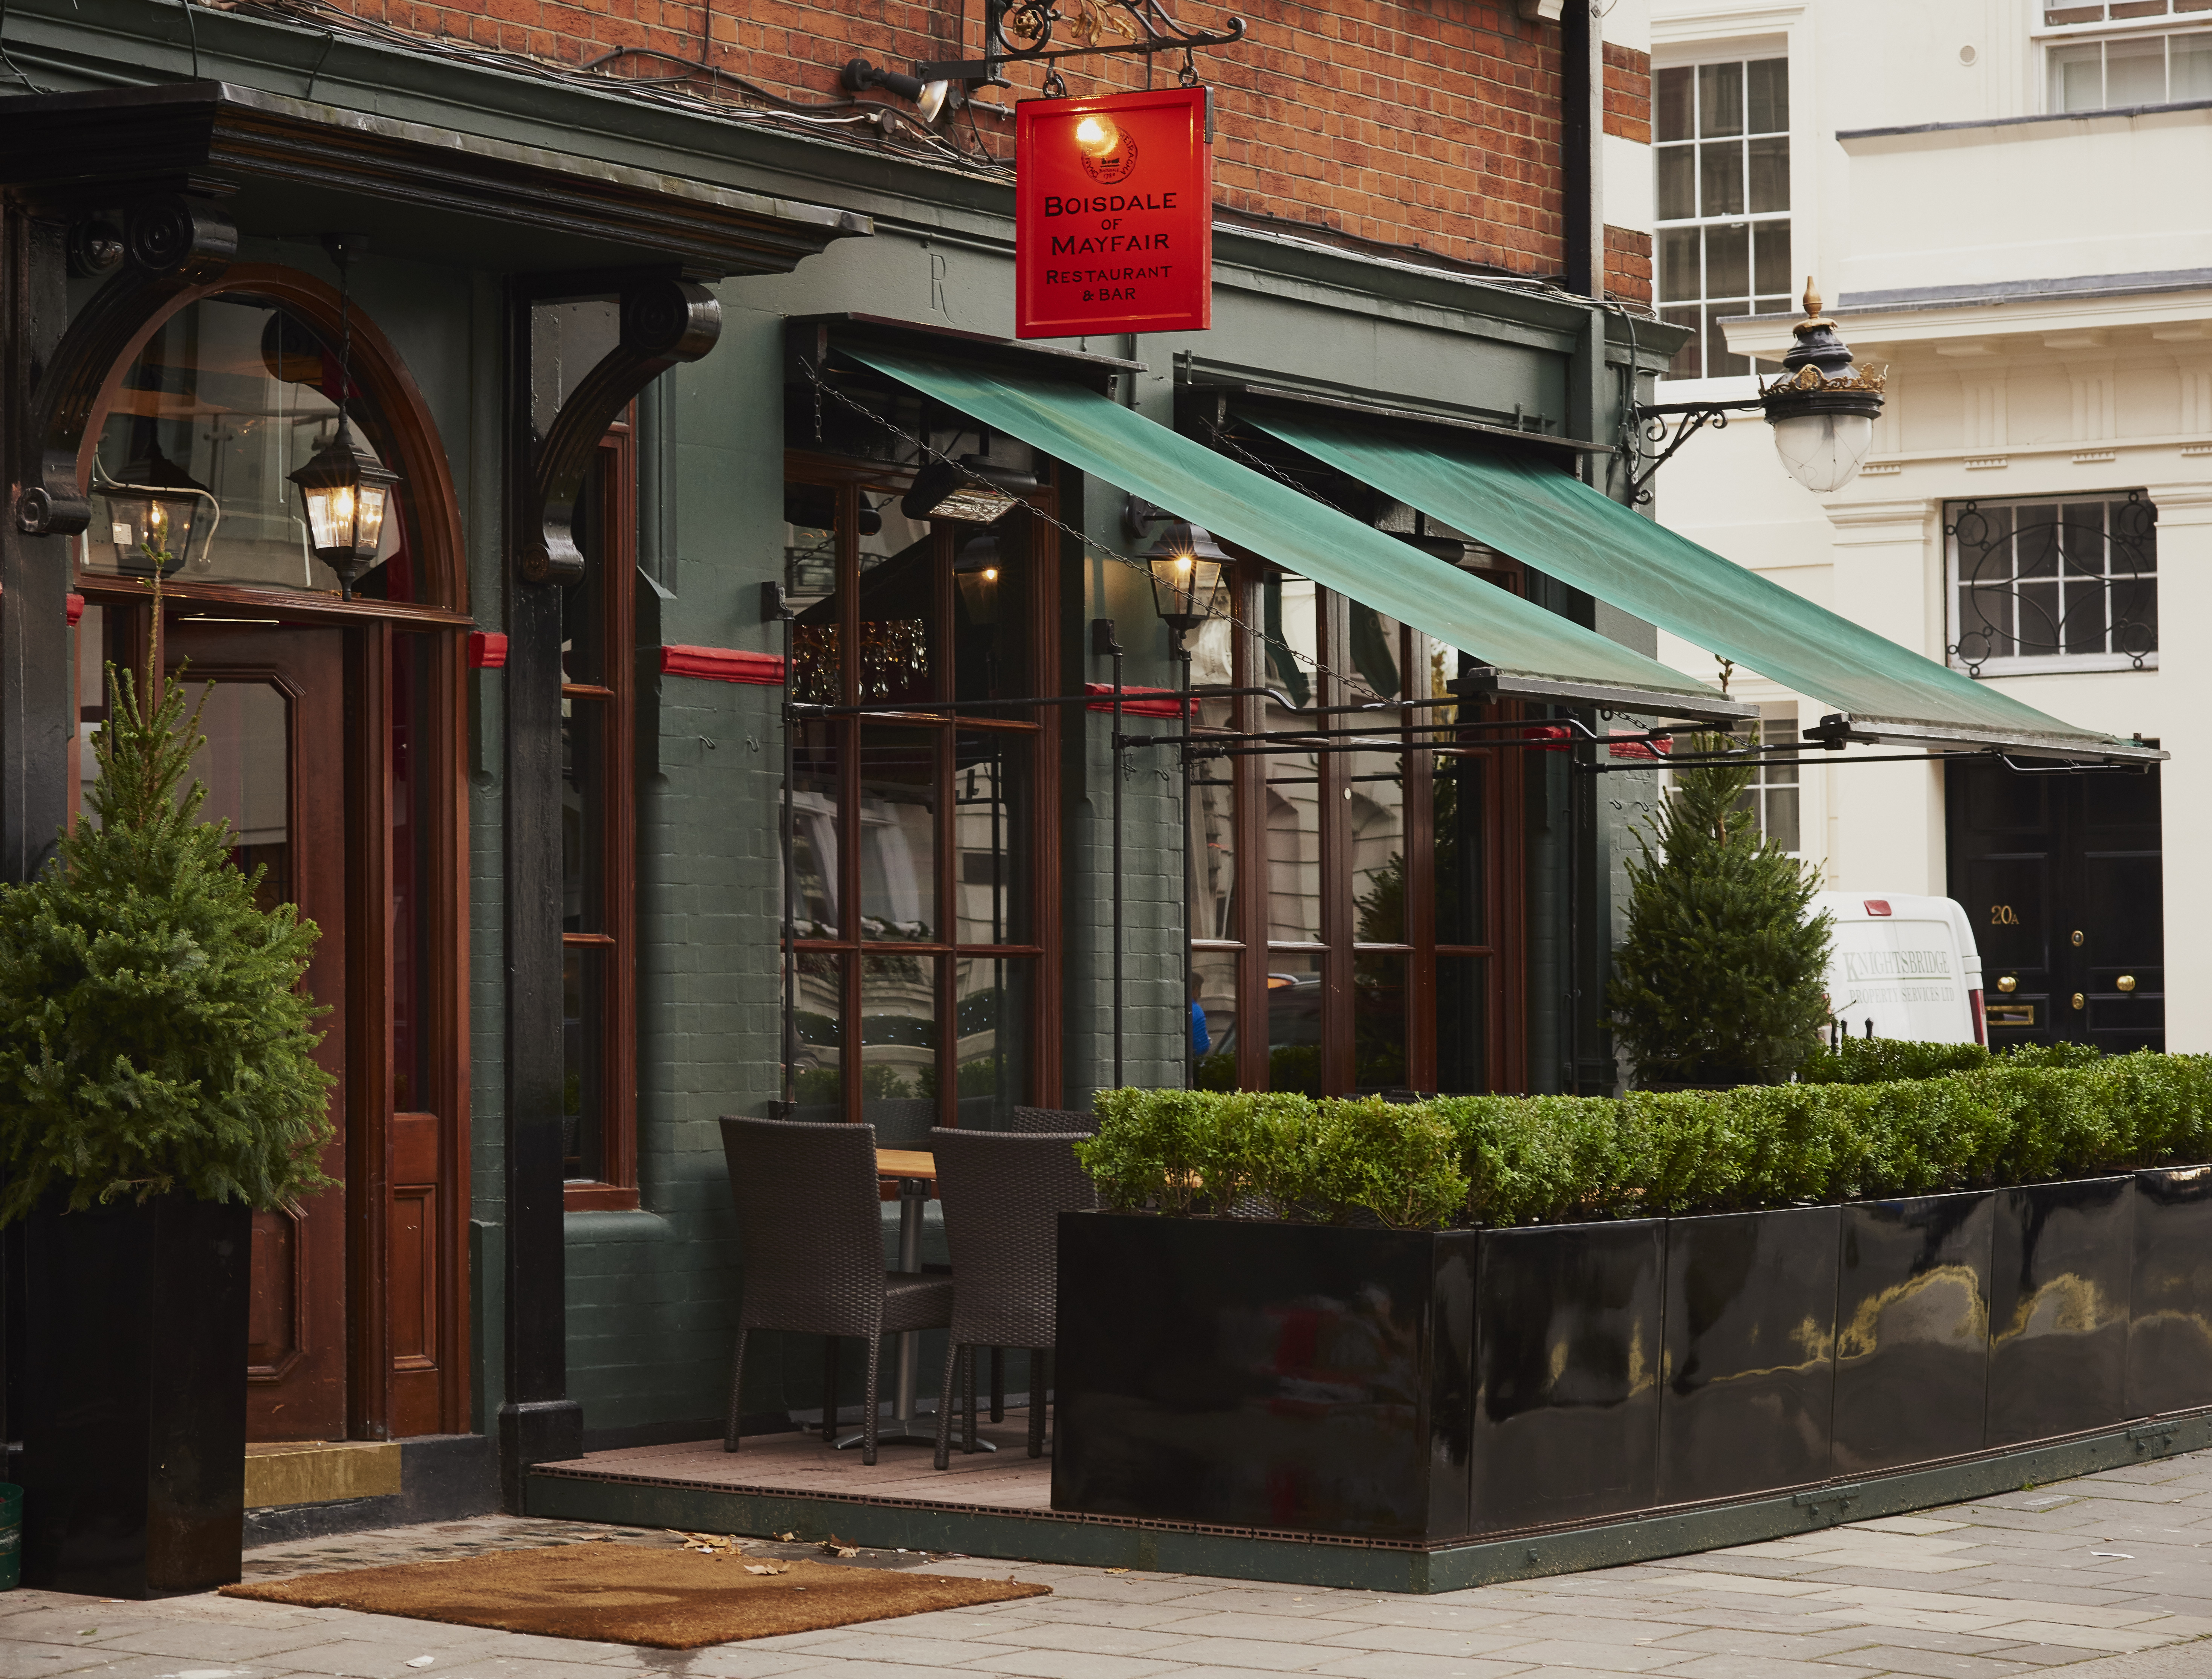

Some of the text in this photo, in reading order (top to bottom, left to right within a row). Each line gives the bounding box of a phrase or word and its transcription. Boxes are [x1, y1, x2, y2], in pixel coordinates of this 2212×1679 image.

[1045, 192, 1176, 217] BOISDALE
[1102, 219, 1122, 230] OF
[1052, 234, 1169, 255] MAYFAIR
[1047, 266, 1172, 284] RESTAURANT
[1082, 288, 1135, 301] & BAR
[1991, 905, 2019, 924] 20A
[1842, 951, 1949, 982] KNIGHTSBRIDGE
[1849, 987, 1955, 1004] PROPERTY SERVICES LTD
